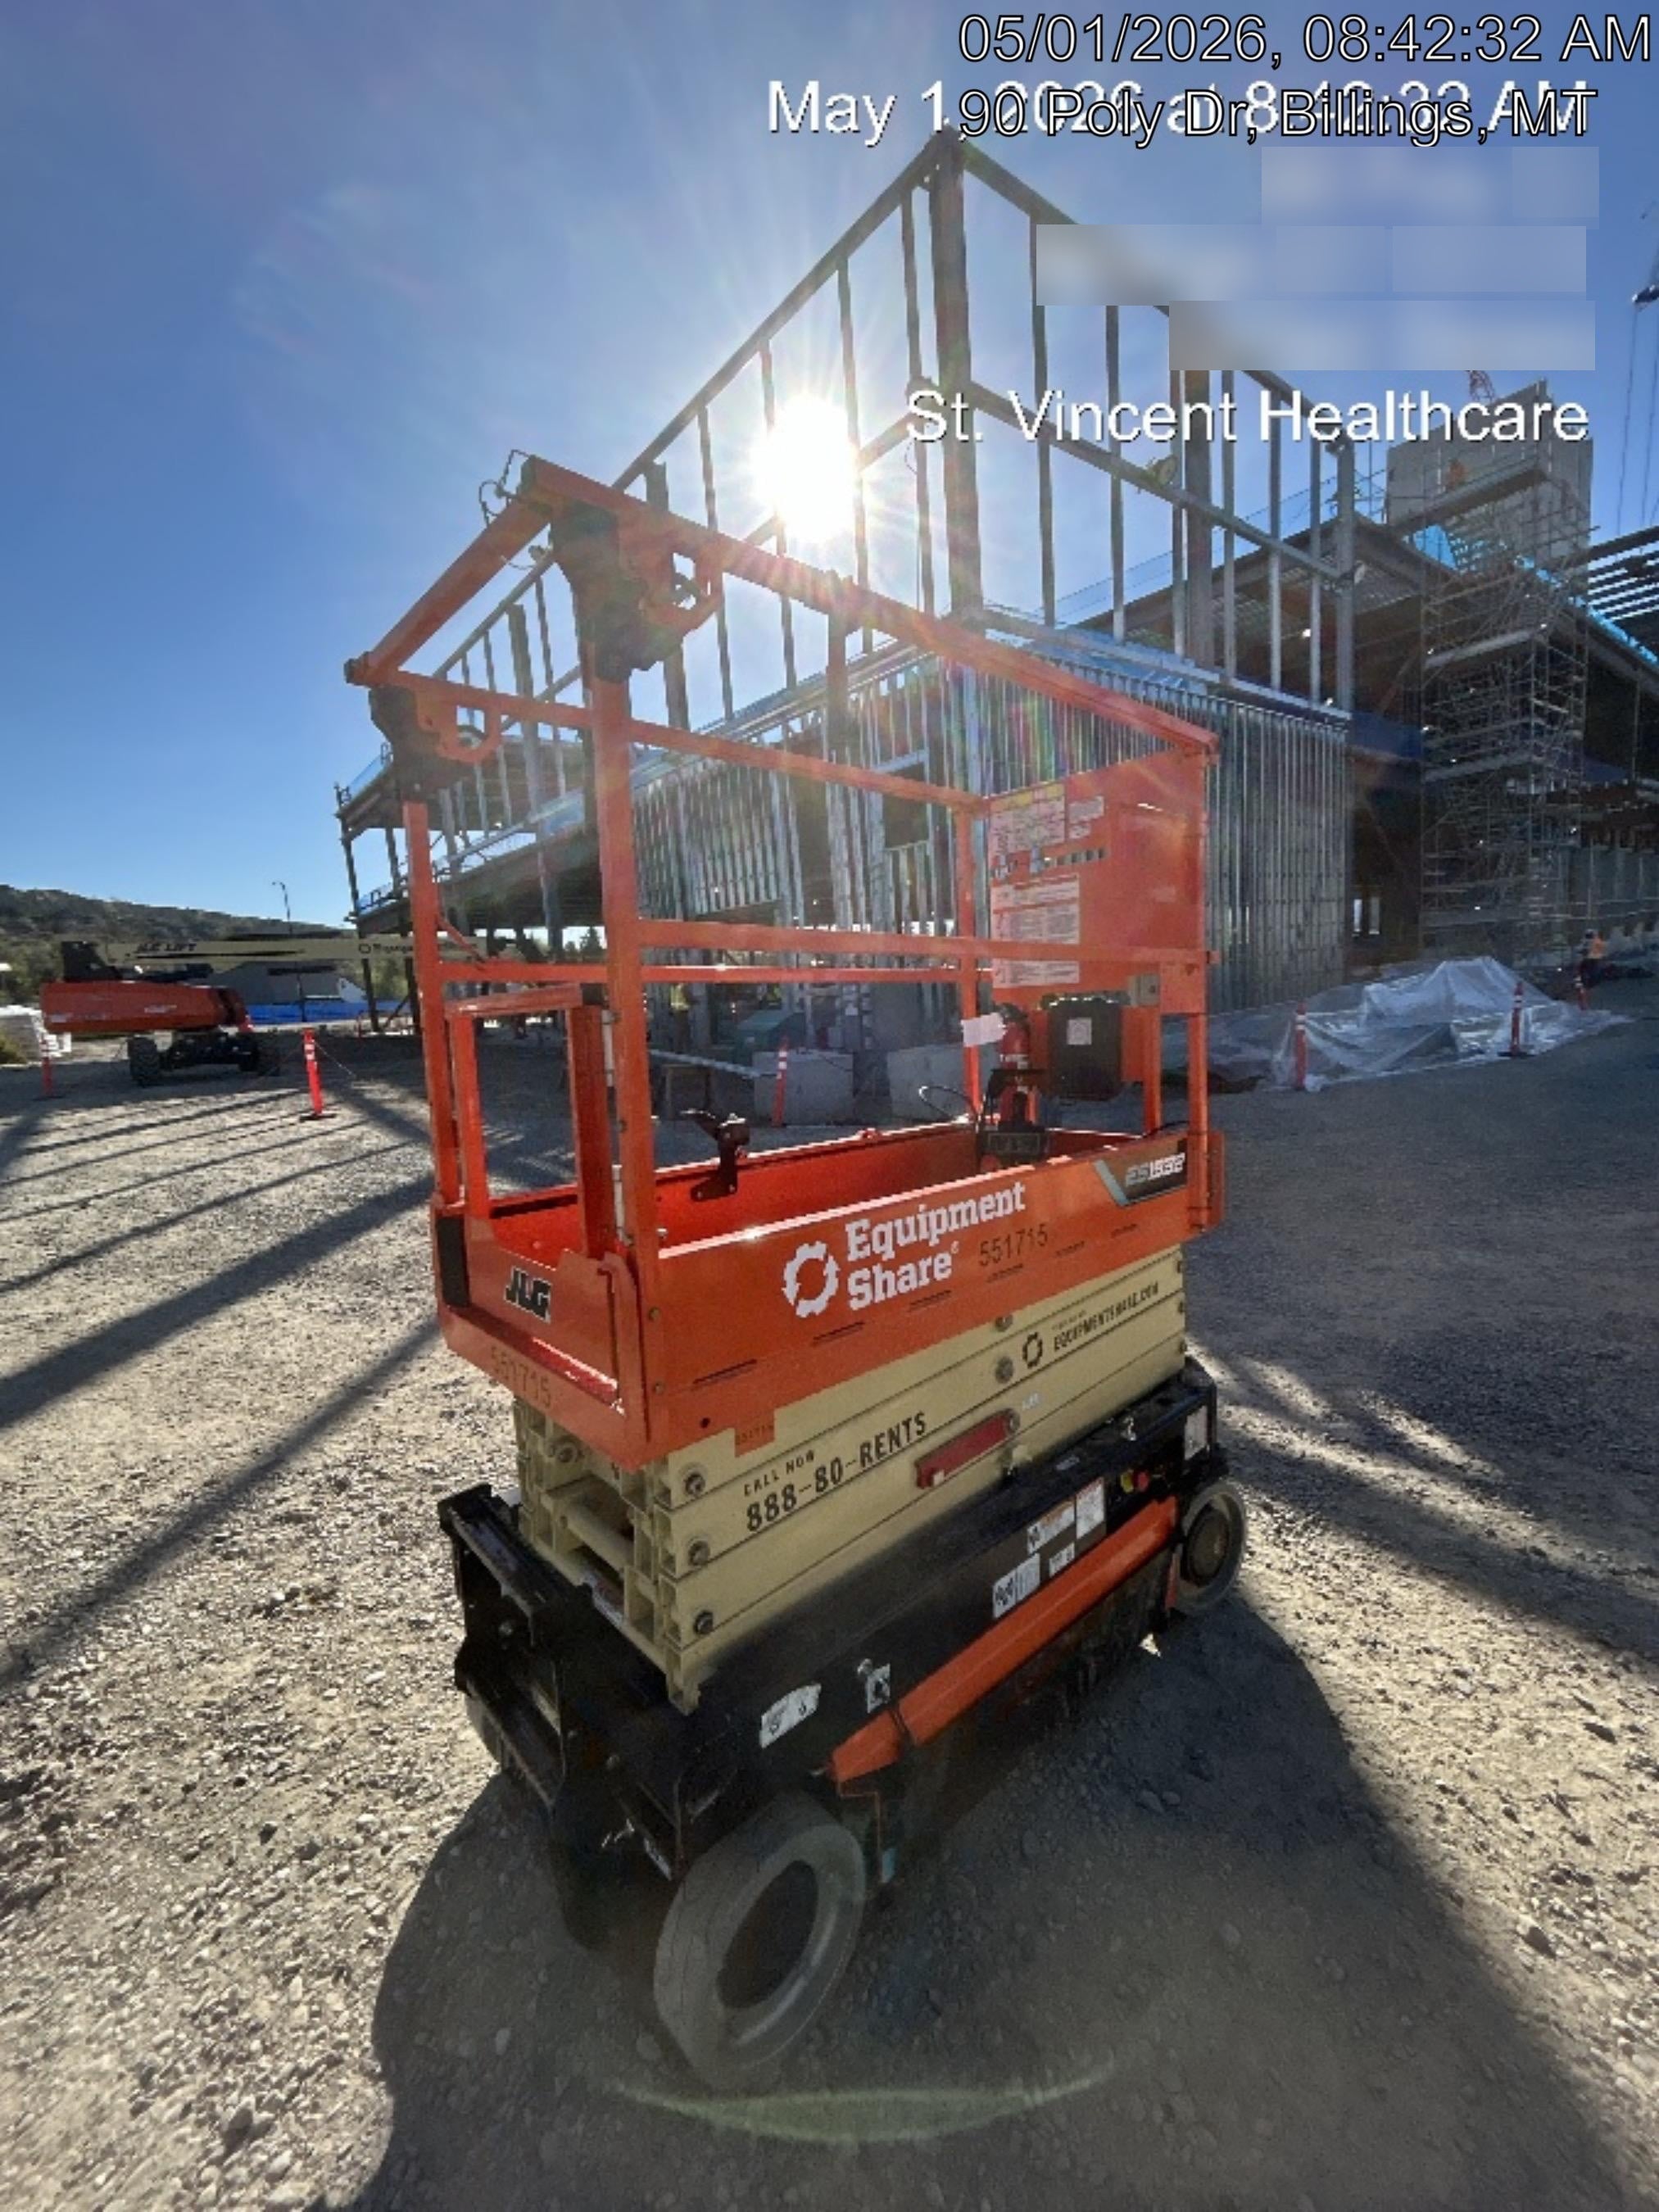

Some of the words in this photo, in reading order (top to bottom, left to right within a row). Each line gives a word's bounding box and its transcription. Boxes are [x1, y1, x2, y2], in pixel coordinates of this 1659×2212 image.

[845, 1181, 1026, 1262] Equipment
[979, 1222, 1049, 1267] 551715
[503, 1266, 552, 1325] JLG
[743, 1468, 780, 1498] CALL
[785, 1449, 816, 1475] NOW
[746, 1409, 926, 1532] 888-80-RENTS
